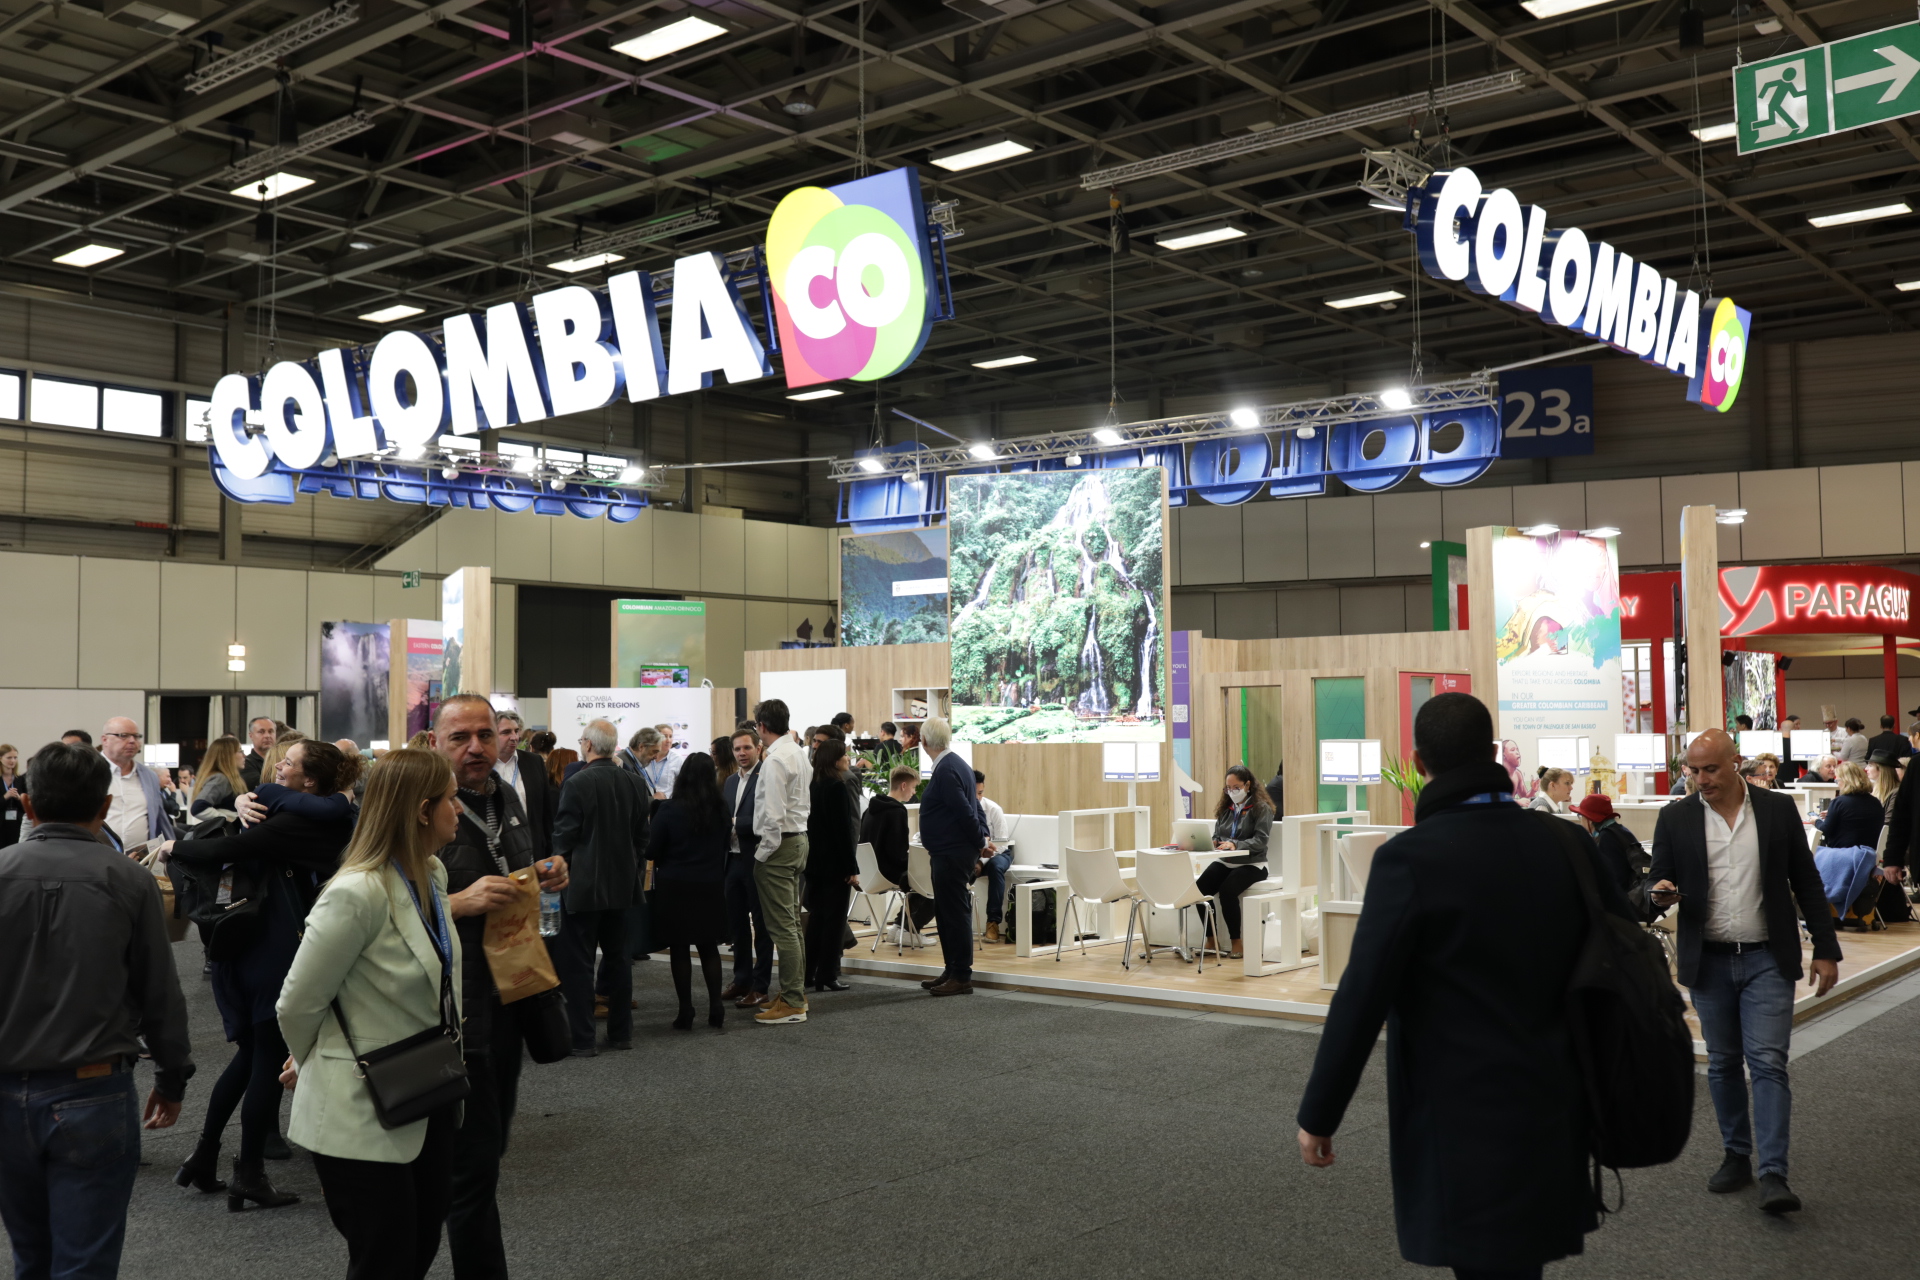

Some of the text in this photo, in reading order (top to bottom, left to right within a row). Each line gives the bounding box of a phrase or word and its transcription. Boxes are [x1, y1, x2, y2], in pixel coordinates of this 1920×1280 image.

[784, 233, 910, 339] CO
[1434, 167, 1699, 378] COLOMBIA
[211, 251, 763, 479] COLOMBIA
[1711, 330, 1743, 387] CO
[1505, 388, 1591, 439] 23a
[1785, 584, 1910, 620] PARAGUAY
